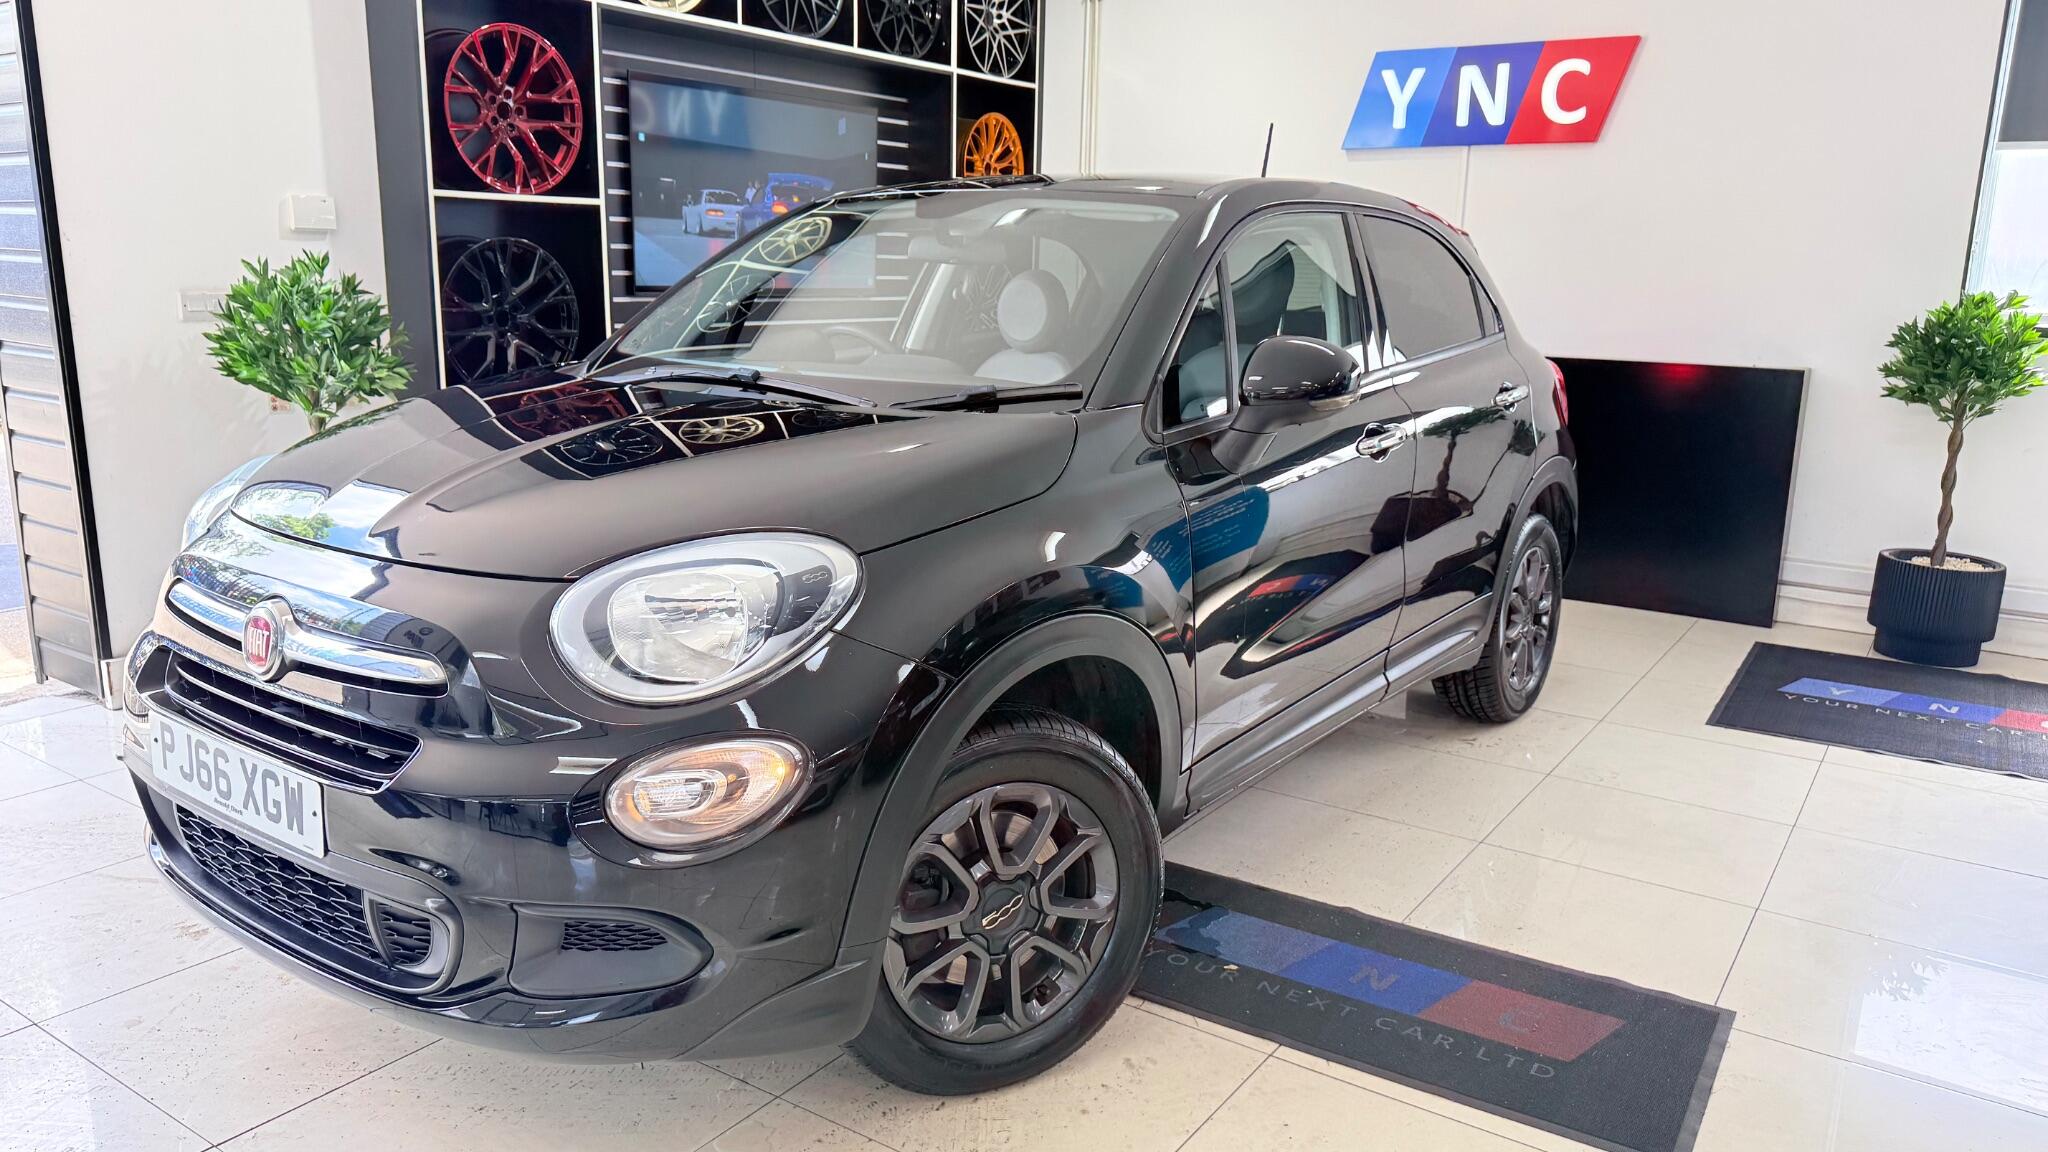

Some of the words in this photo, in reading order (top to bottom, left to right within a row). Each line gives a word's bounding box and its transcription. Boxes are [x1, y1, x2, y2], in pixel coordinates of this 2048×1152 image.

[1380, 58, 1592, 130] YNC
[802, 571, 828, 584] 500
[247, 626, 270, 658] FIAT
[1784, 694, 1859, 709] YOUR
[1875, 708, 1950, 724] NEXT
[1965, 723, 2025, 736] CAR
[159, 720, 232, 801] PJ66
[239, 757, 304, 836] XGW
[982, 894, 1024, 930] 500
[1256, 980, 1359, 1017] NEXT
[1375, 1017, 1455, 1049] CAR
[1476, 1046, 1555, 1078] LTD
